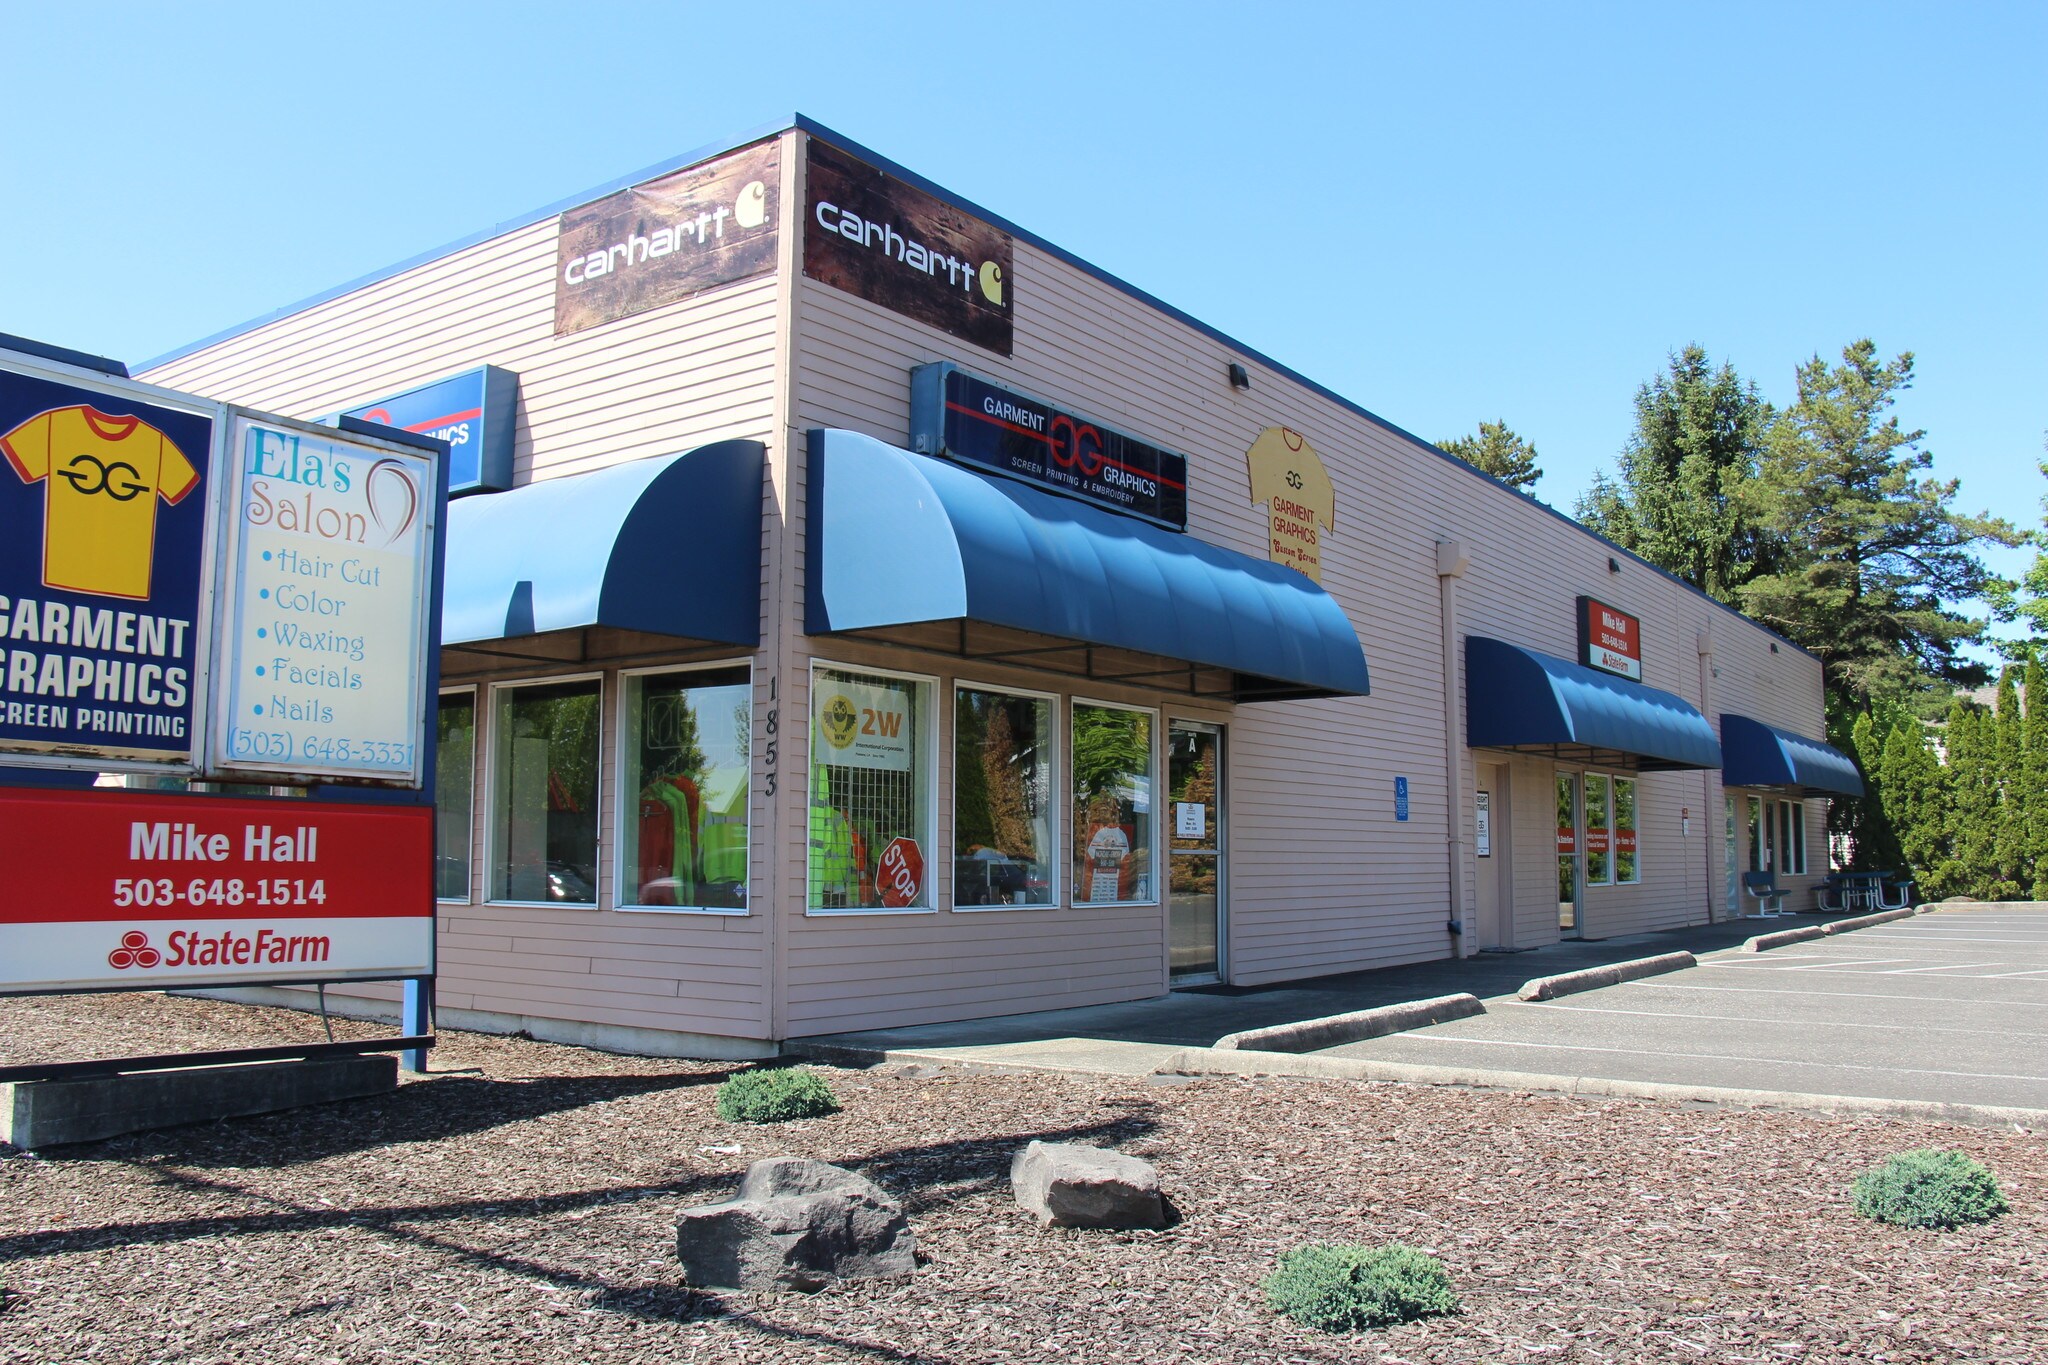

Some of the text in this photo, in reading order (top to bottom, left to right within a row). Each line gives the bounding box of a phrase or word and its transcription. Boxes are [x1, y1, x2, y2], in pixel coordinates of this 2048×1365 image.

[564, 206, 730, 285] carhartt
[816, 201, 975, 292] carhartt
[984, 396, 1045, 432] GARMENT
[248, 427, 350, 493] Ela's
[1011, 456, 1135, 504] SCREEN PRINTING & EMBROIDERY
[1103, 466, 1156, 498] GRAPHICS
[245, 481, 366, 544] Salon
[1273, 496, 1315, 525] GARMENT
[1273, 516, 1316, 545] GRAPHICS
[277, 549, 380, 587] Hair Cut
[276, 584, 346, 616] Color
[1602, 611, 1626, 634] Mike Hall
[274, 621, 364, 662] Waxing
[0, 648, 187, 707] RAPHICS
[272, 657, 362, 690] Facials
[0, 701, 185, 738] REEN PRINTING
[270, 695, 334, 724] Nails
[861, 708, 903, 738] 2W
[229, 727, 293, 762] (503)
[855, 742, 882, 750] International
[1188, 738, 1196, 753] A
[129, 821, 318, 863] Mike Hall
[884, 844, 916, 898] STOP
[113, 878, 327, 907] 503-648-1514
